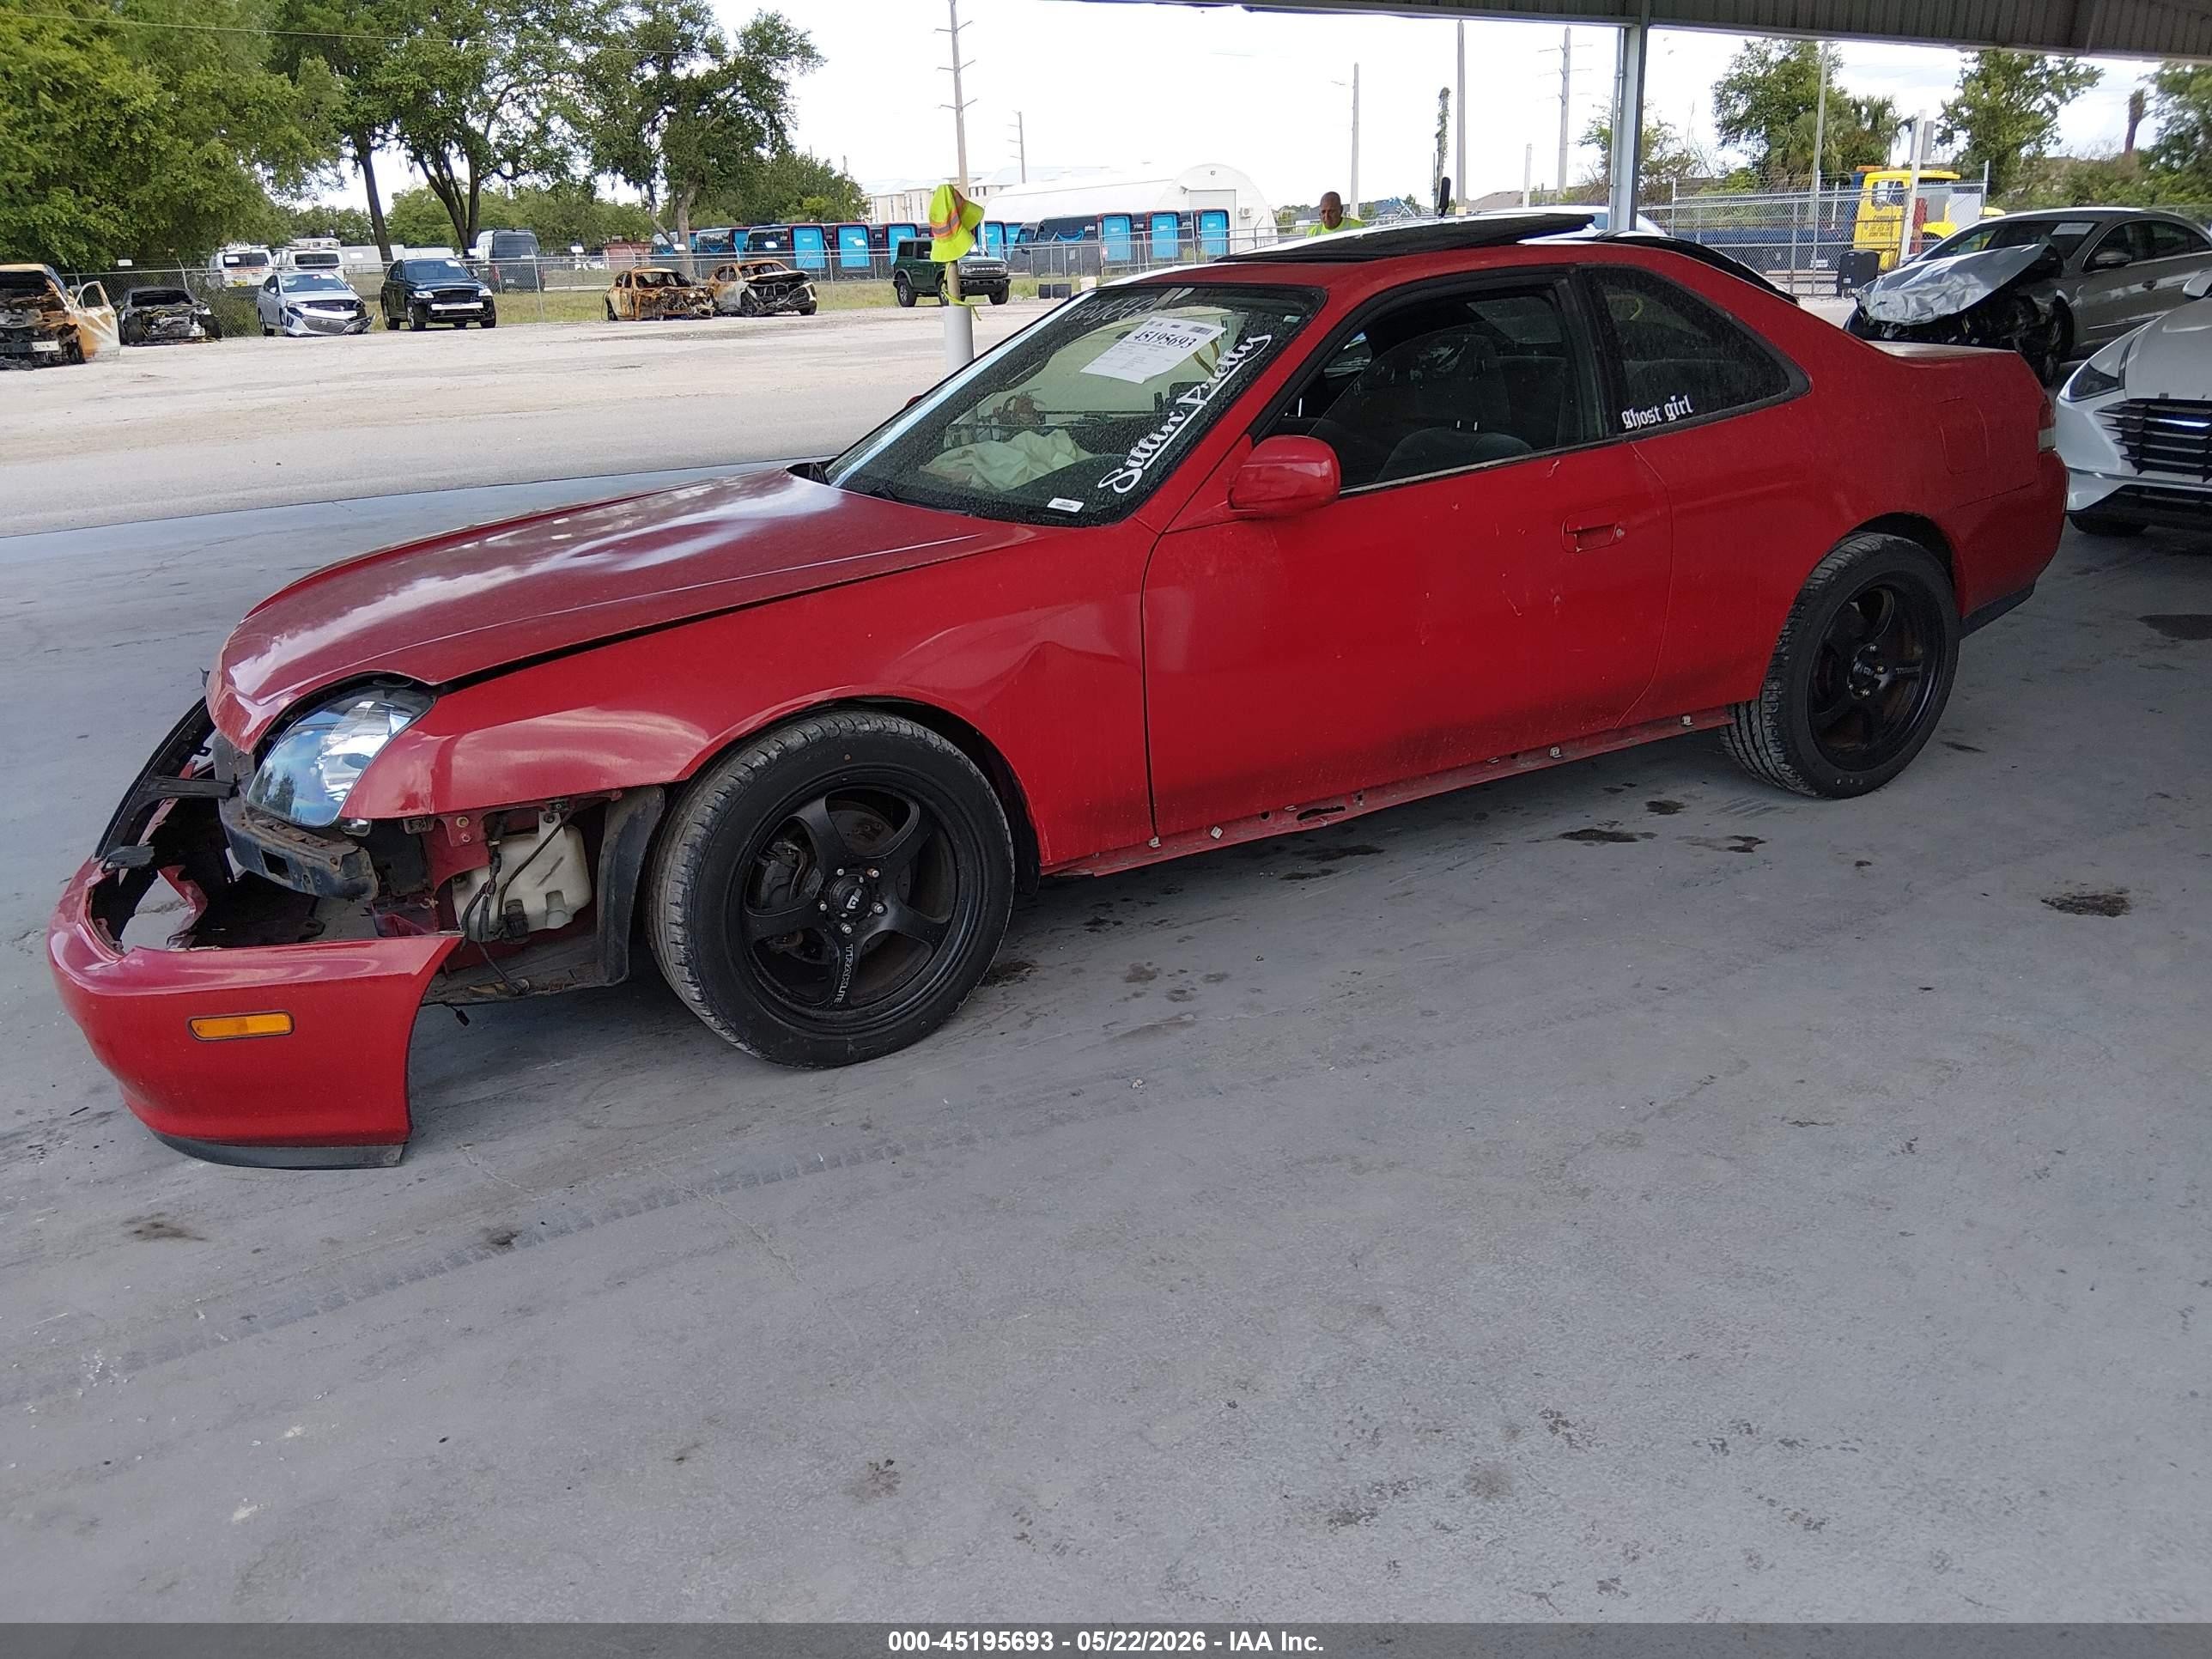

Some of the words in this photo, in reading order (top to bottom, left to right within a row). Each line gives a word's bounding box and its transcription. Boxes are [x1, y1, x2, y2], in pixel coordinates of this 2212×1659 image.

[1133, 330, 1198, 349] 45195693
[1176, 334, 1273, 406] Pretty
[1663, 394, 1694, 422] girl
